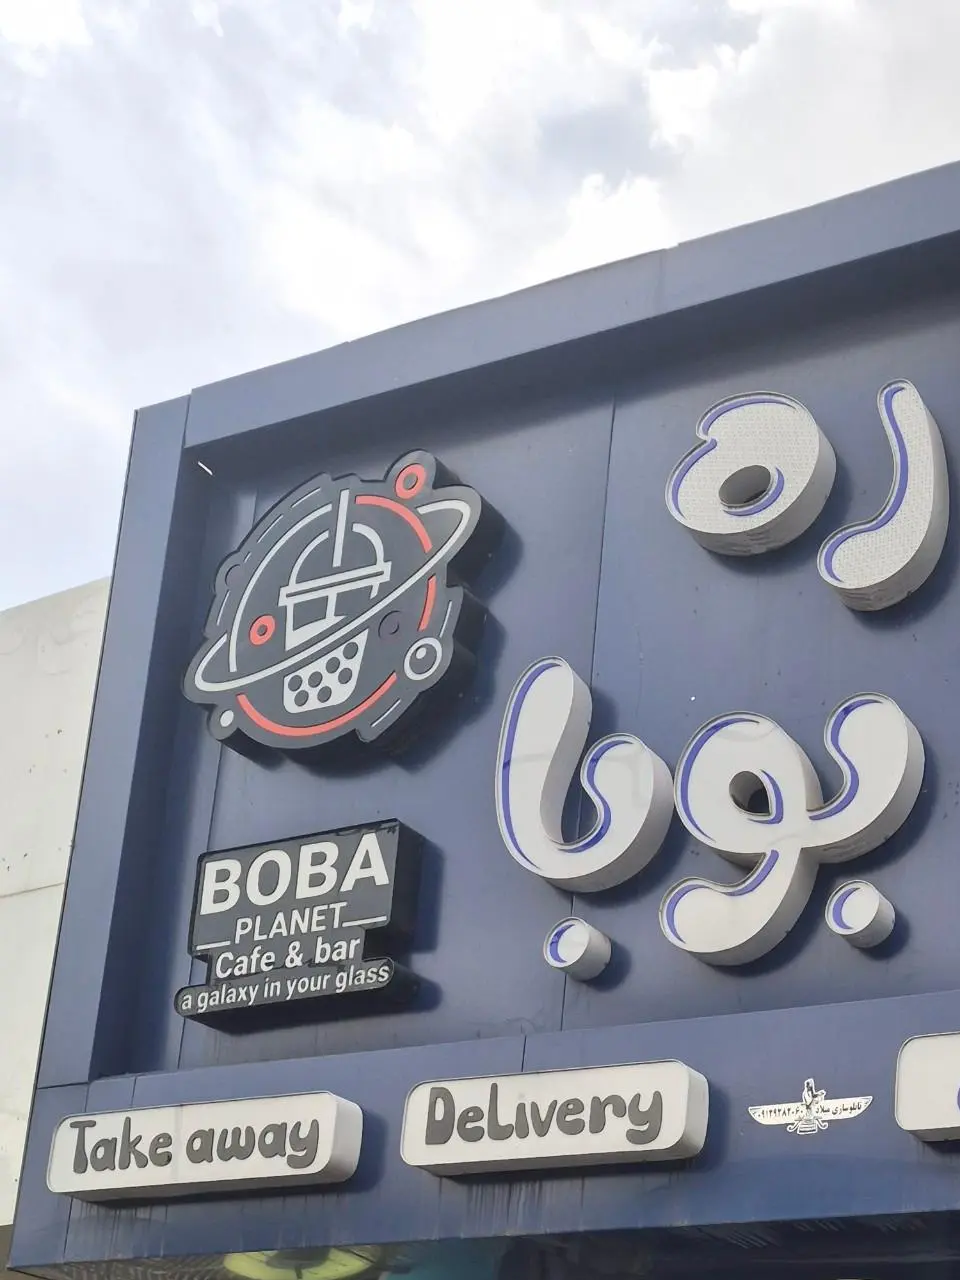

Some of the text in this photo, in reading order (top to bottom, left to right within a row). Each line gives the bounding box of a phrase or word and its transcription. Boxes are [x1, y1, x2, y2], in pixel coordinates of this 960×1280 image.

[495, 656, 925, 980] بوبا
[200, 832, 390, 916] BOBA
[234, 901, 348, 945] PLANET
[214, 936, 361, 979] Cafe & bar
[181, 963, 390, 1014] a galaxy in your glass
[68, 1114, 320, 1175] Take away
